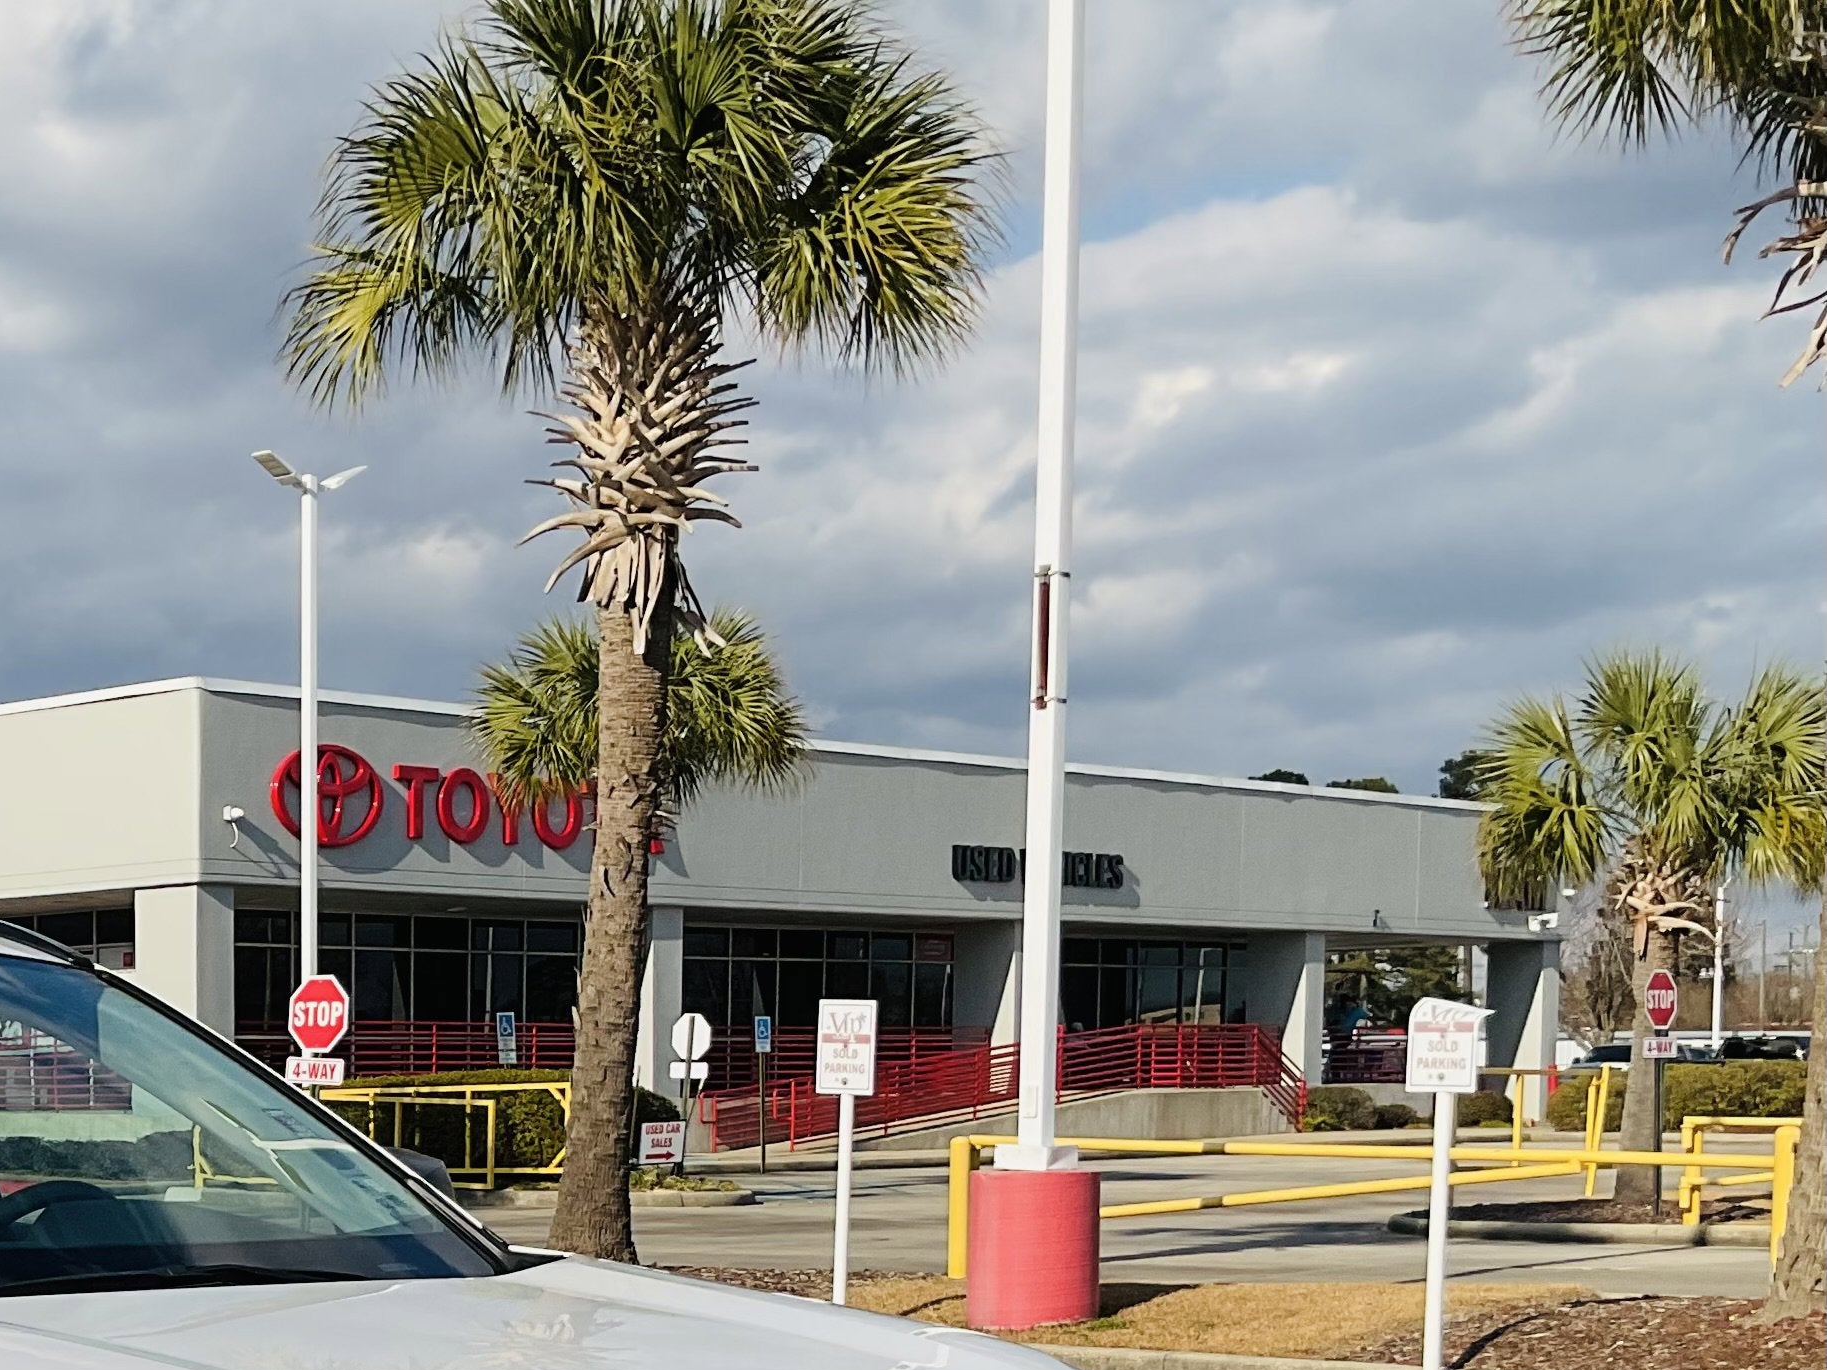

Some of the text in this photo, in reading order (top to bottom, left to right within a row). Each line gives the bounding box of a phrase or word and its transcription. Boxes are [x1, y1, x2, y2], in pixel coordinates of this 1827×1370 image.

[392, 763, 665, 855] TOYO
[951, 845, 1016, 882] USED
[1647, 989, 1674, 1009] STOP
[292, 1000, 344, 1028] STOP
[1427, 1040, 1459, 1052] SOLD
[1647, 1041, 1673, 1053] 4-WAY
[833, 1048, 858, 1059] SOLD
[824, 1062, 865, 1074] PARKING
[1416, 1057, 1467, 1070] PARKING
[292, 1062, 337, 1080] 4-WAY
[645, 1123, 681, 1135] USED CAR
[650, 1137, 673, 1149] SALES
